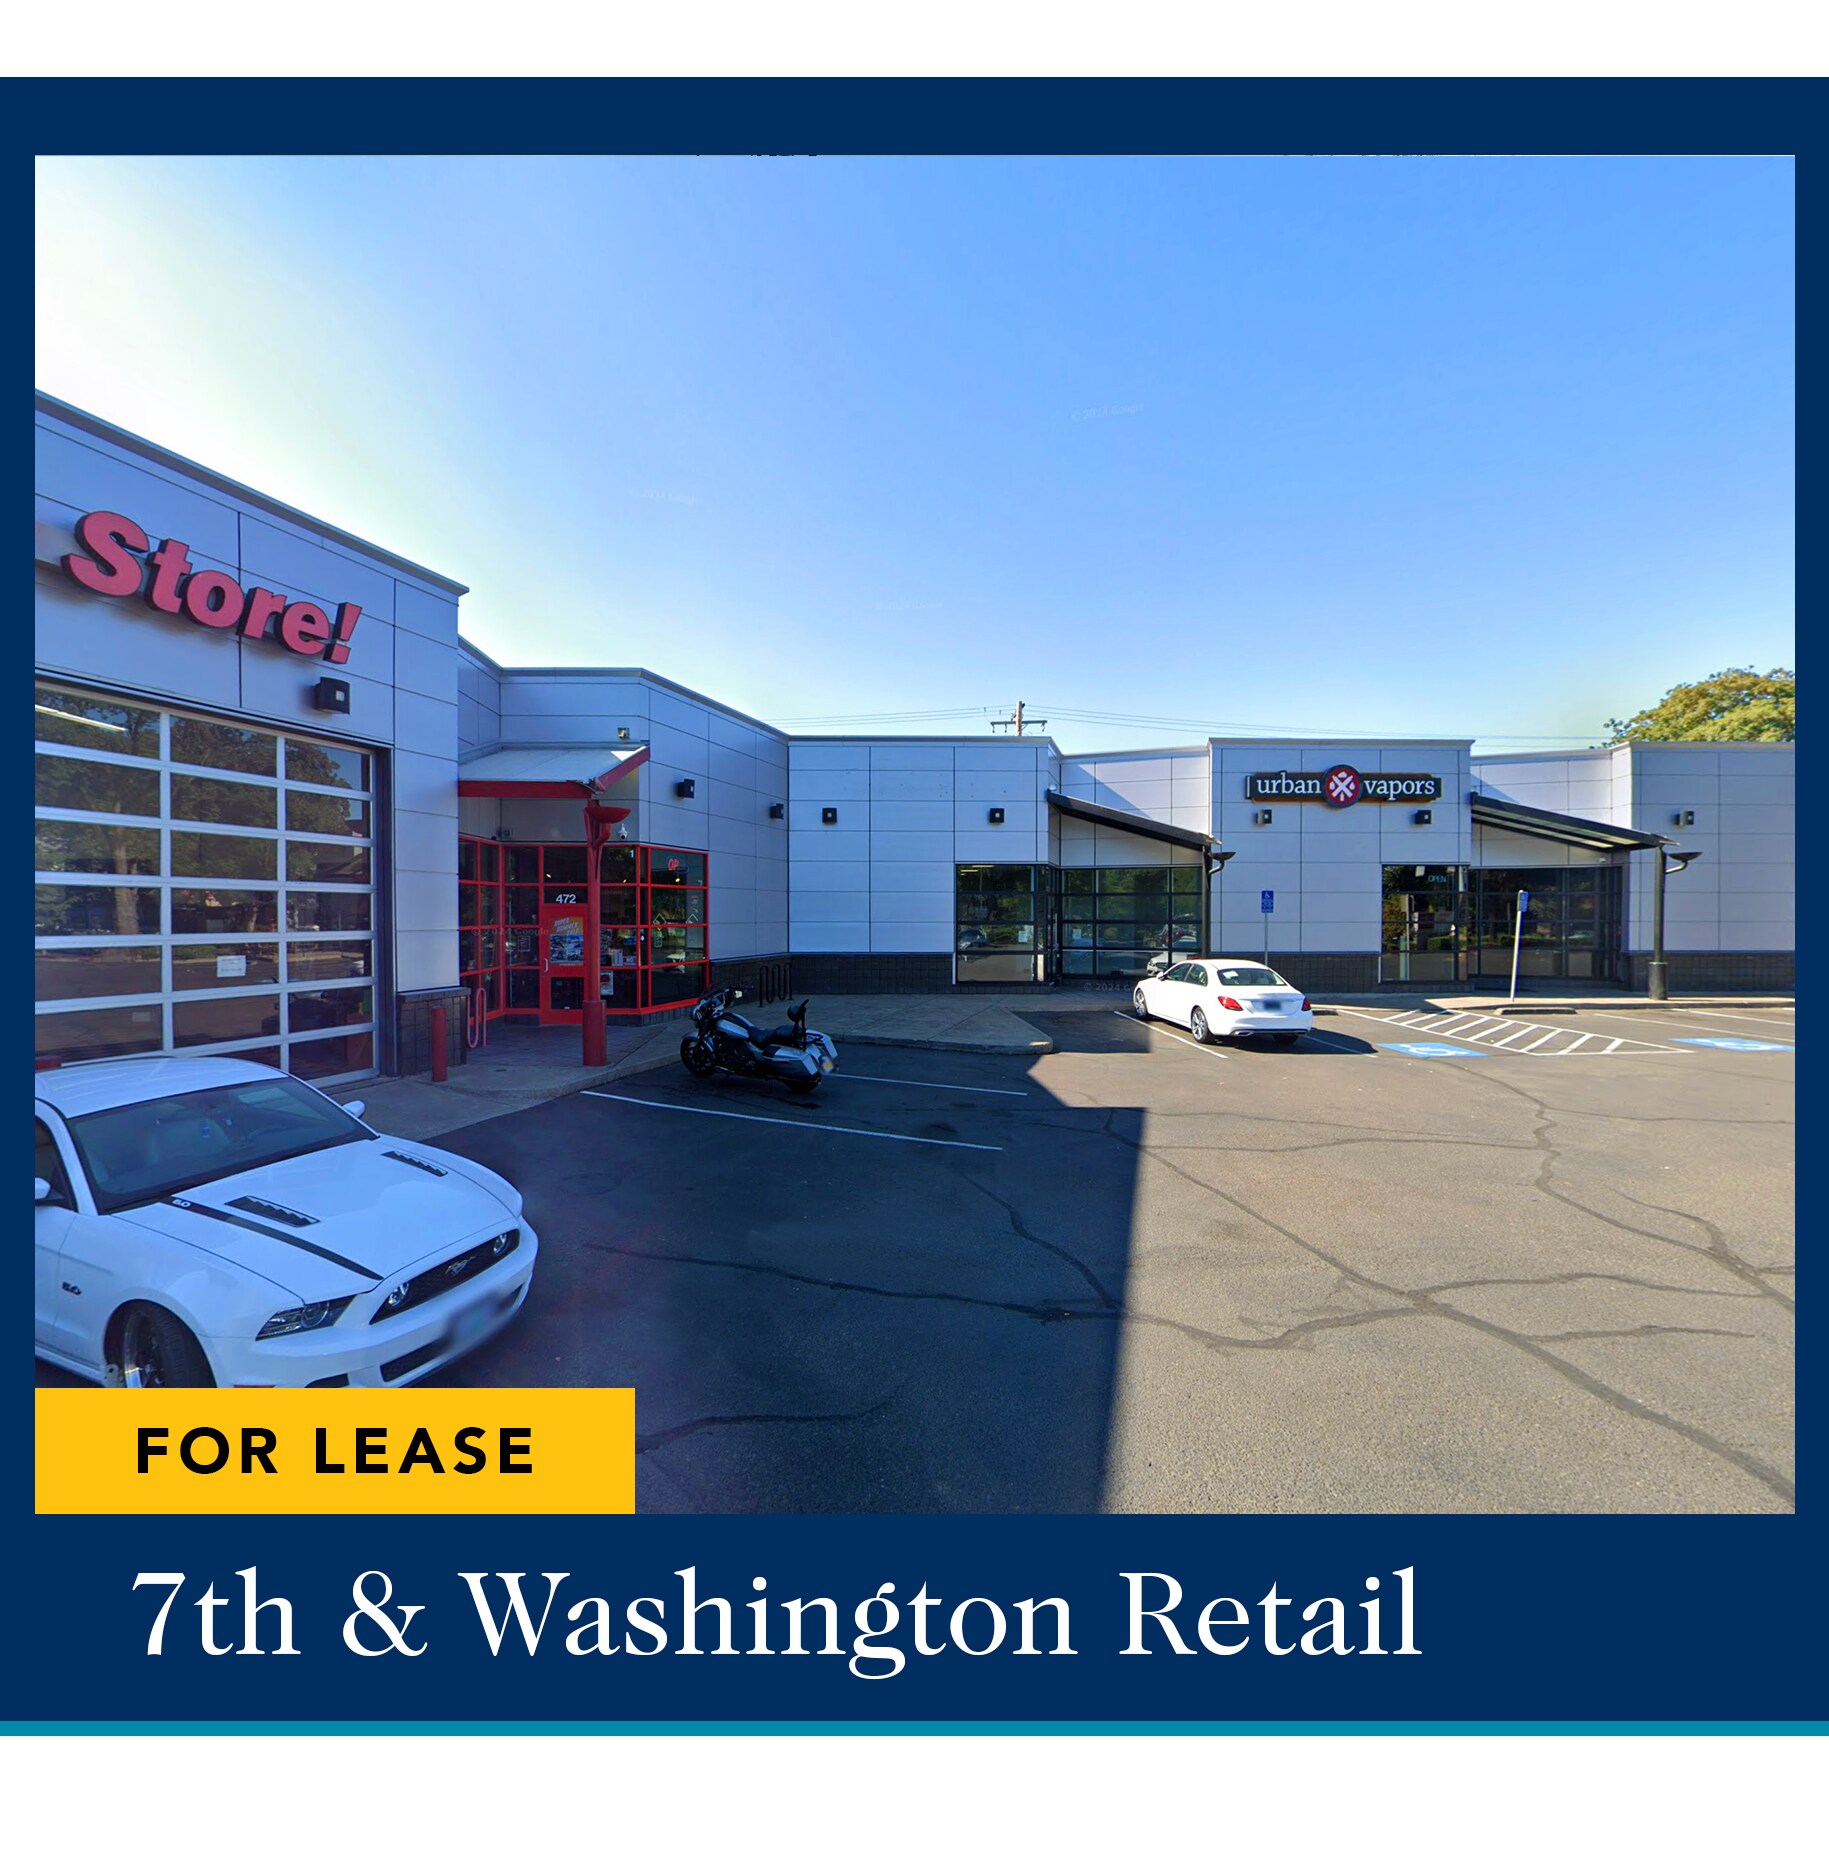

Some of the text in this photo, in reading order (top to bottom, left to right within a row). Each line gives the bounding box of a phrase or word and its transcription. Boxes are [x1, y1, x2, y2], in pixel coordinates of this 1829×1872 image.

[61, 510, 363, 664] Store!
[1256, 772, 1436, 800] urban vapors
[555, 893, 577, 904] 472
